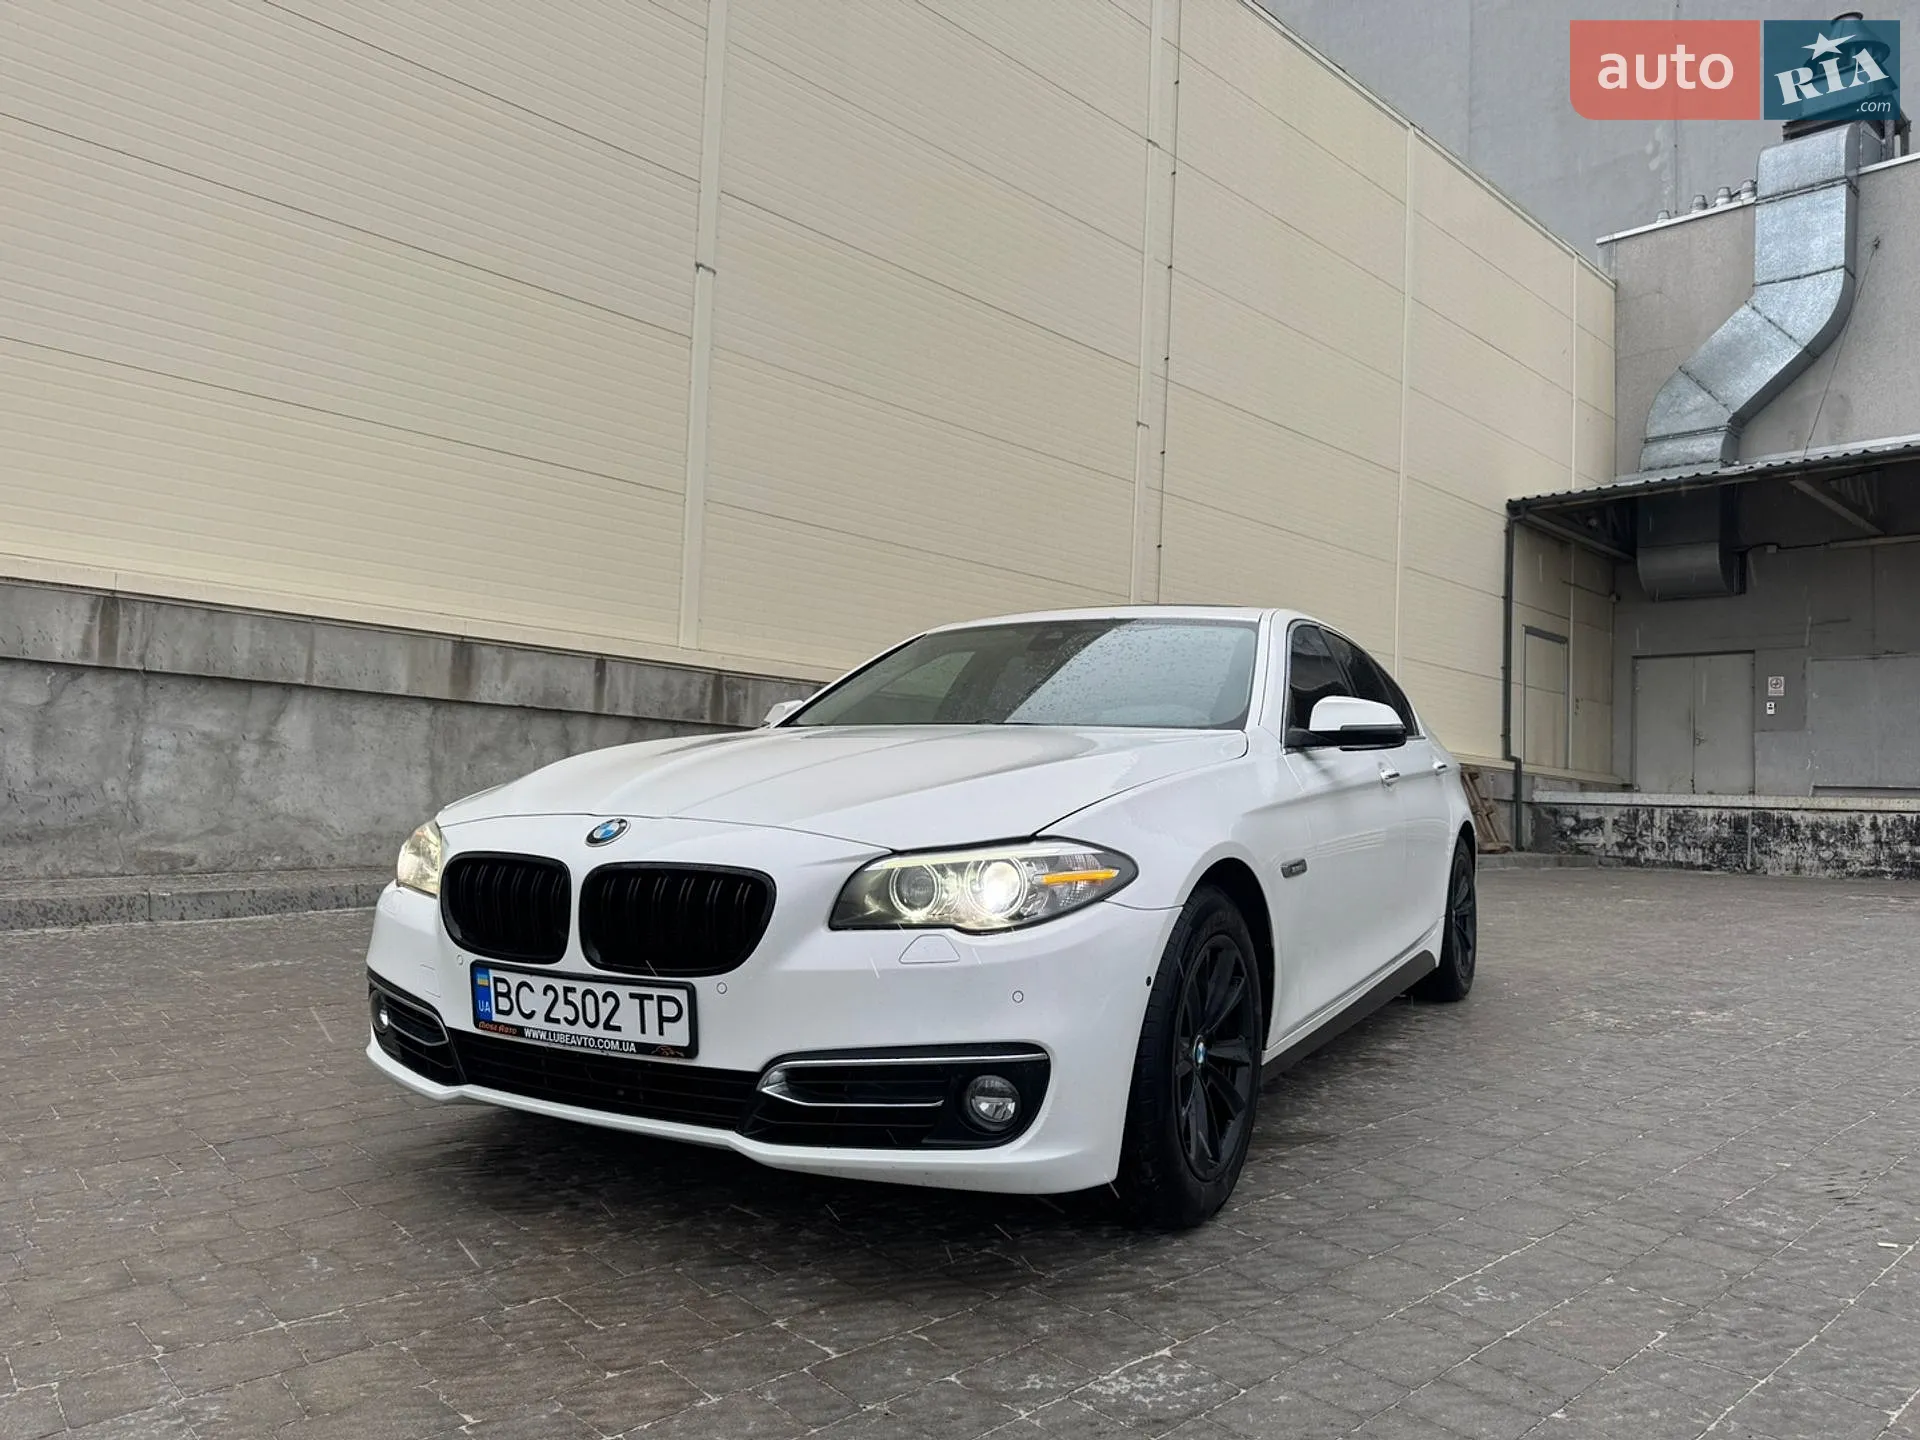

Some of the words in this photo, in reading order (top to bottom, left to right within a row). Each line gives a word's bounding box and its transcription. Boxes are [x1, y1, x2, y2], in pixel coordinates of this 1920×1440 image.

[478, 999, 491, 1013] UA
[493, 975, 536, 1020] BC
[542, 984, 622, 1032] 2502
[628, 992, 684, 1037] TP
[524, 1026, 637, 1053] WWW.LUBEAVTO.COM.UA
